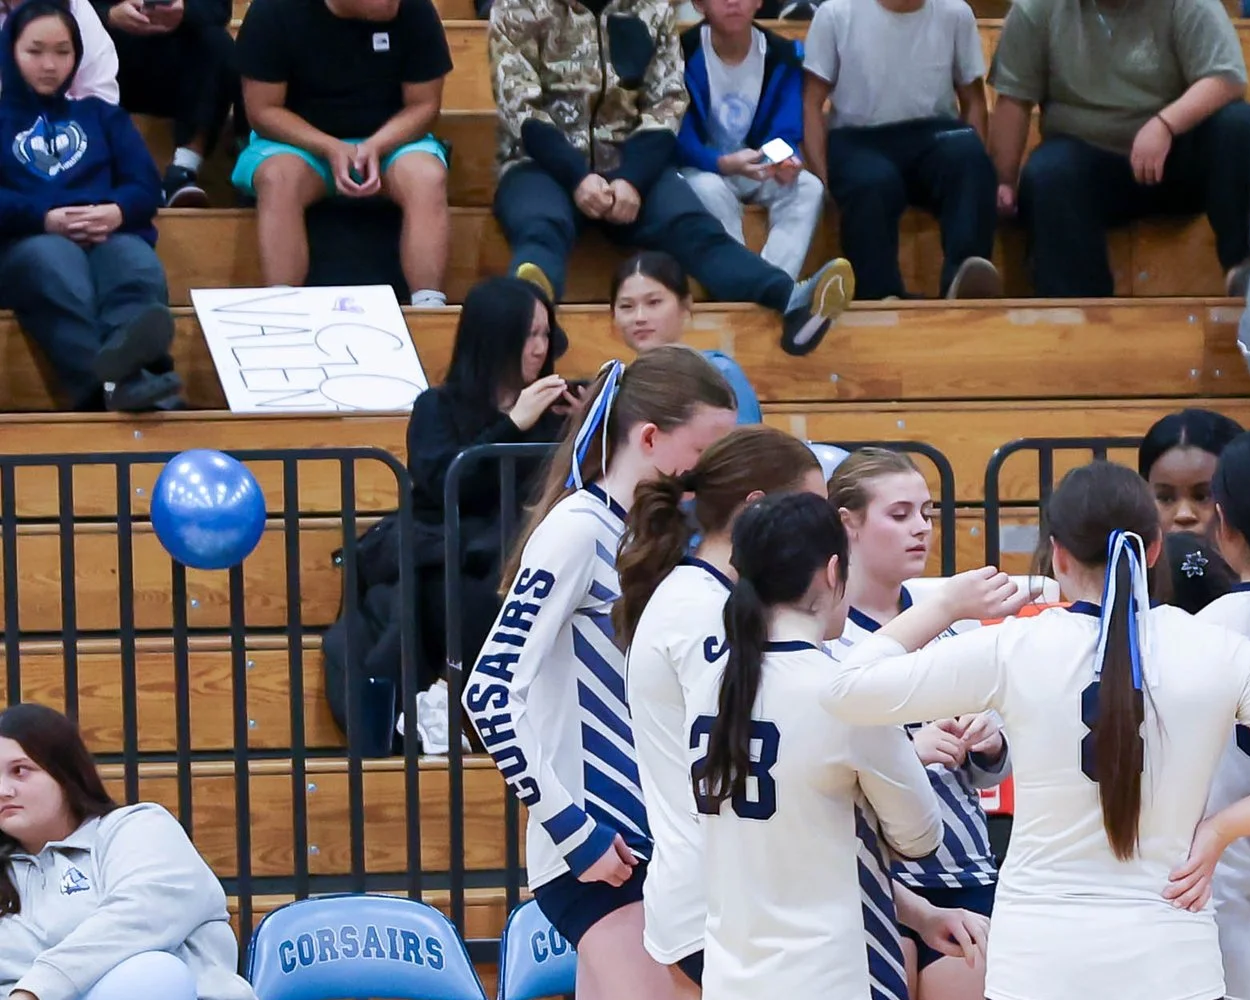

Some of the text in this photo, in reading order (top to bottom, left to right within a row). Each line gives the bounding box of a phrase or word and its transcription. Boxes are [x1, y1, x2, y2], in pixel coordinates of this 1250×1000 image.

[210, 290, 340, 411] VALEN
[314, 322, 424, 411] GO
[278, 924, 445, 974] CORSAIRS
[530, 925, 578, 964] CO
